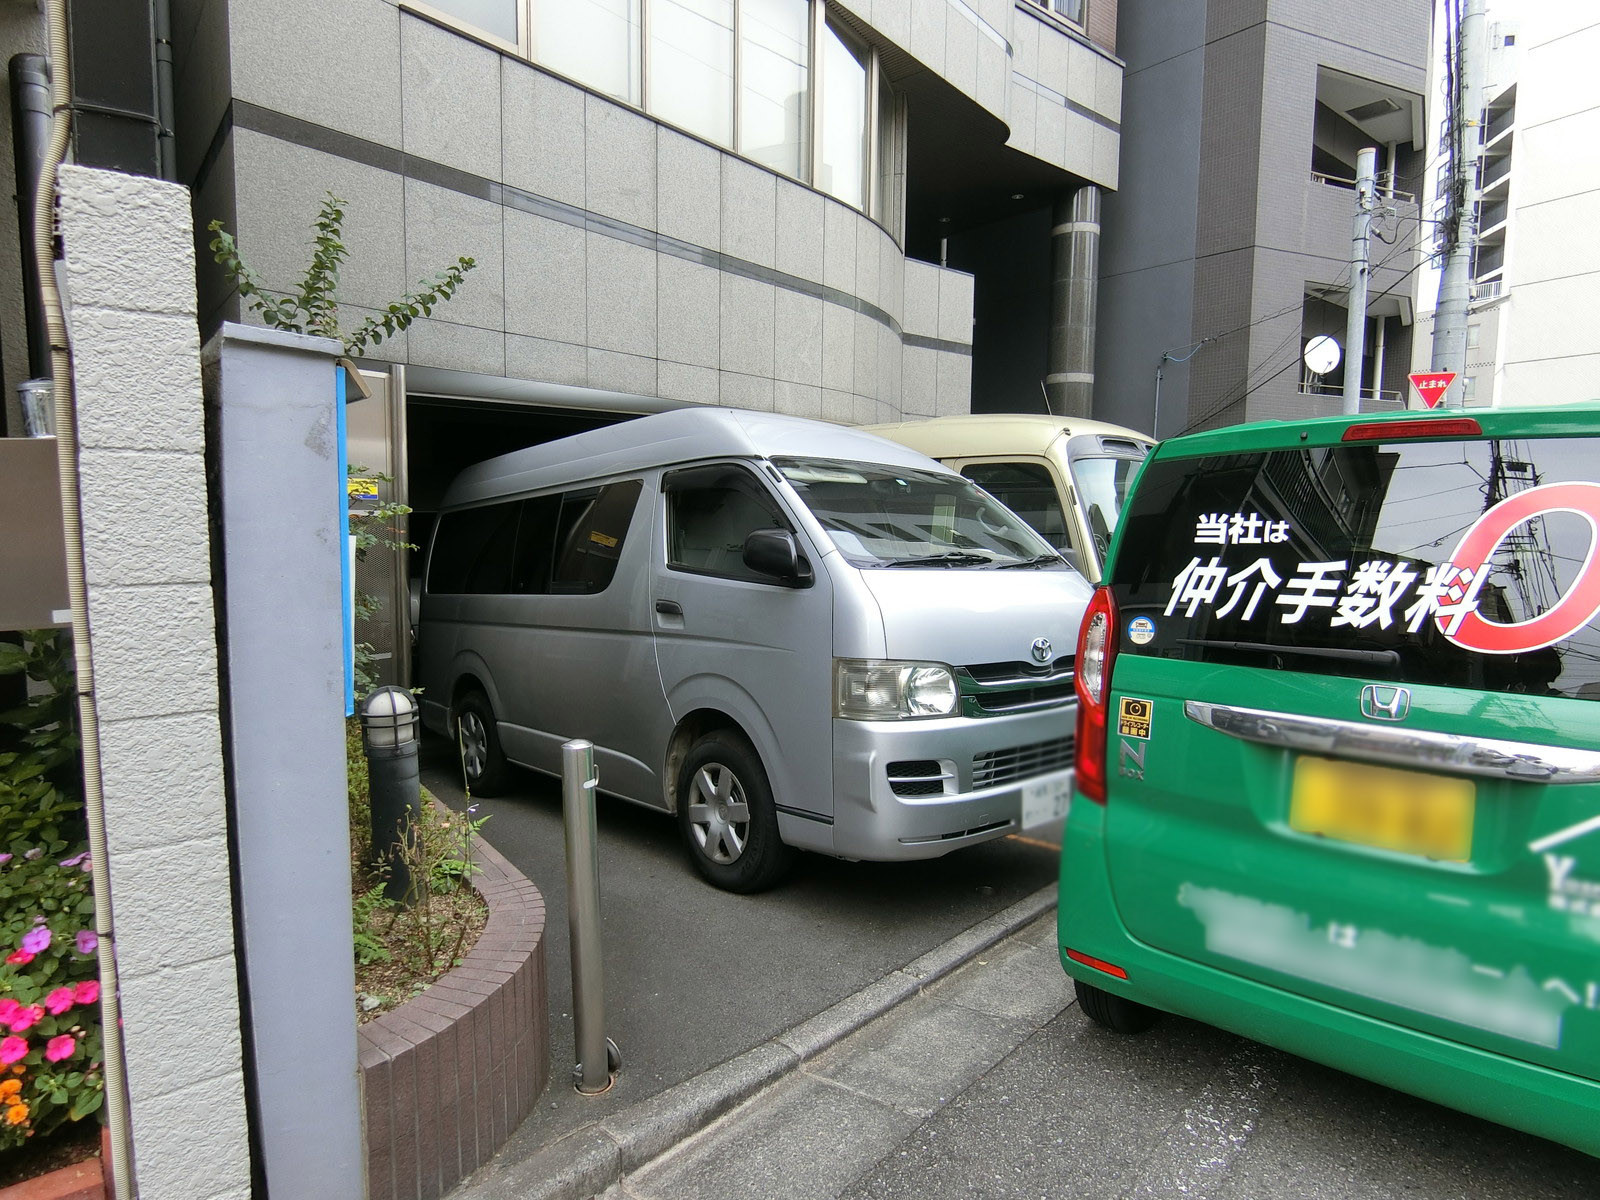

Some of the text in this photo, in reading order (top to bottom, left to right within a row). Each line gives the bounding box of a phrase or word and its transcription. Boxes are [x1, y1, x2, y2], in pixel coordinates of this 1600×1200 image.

[1418, 379, 1447, 389] 止まれ
[1194, 512, 1290, 544] 当社は
[1163, 556, 1492, 636] 仲介手数料
